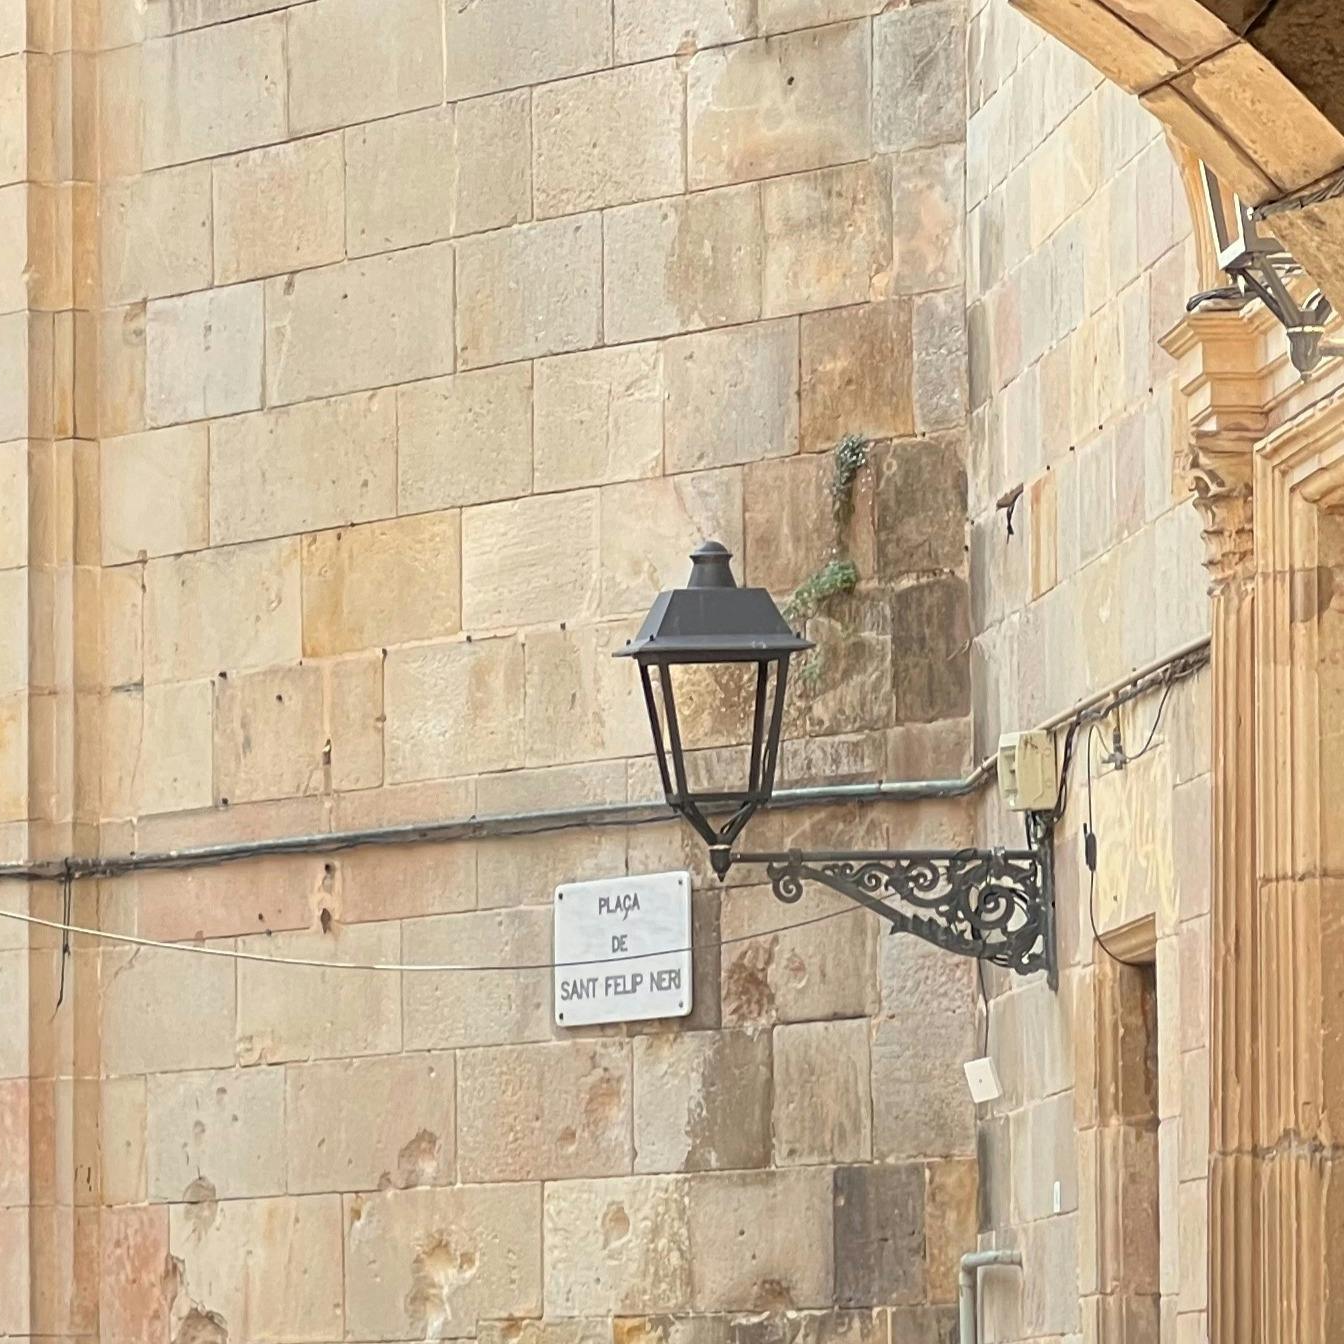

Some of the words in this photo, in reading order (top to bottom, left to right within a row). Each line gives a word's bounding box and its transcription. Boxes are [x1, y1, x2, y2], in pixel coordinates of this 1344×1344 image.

[598, 893, 640, 921] PLAÇA
[611, 934, 628, 953] DE
[560, 977, 598, 1001] SANT
[605, 973, 643, 997] FELIP
[650, 968, 681, 992] NERI
